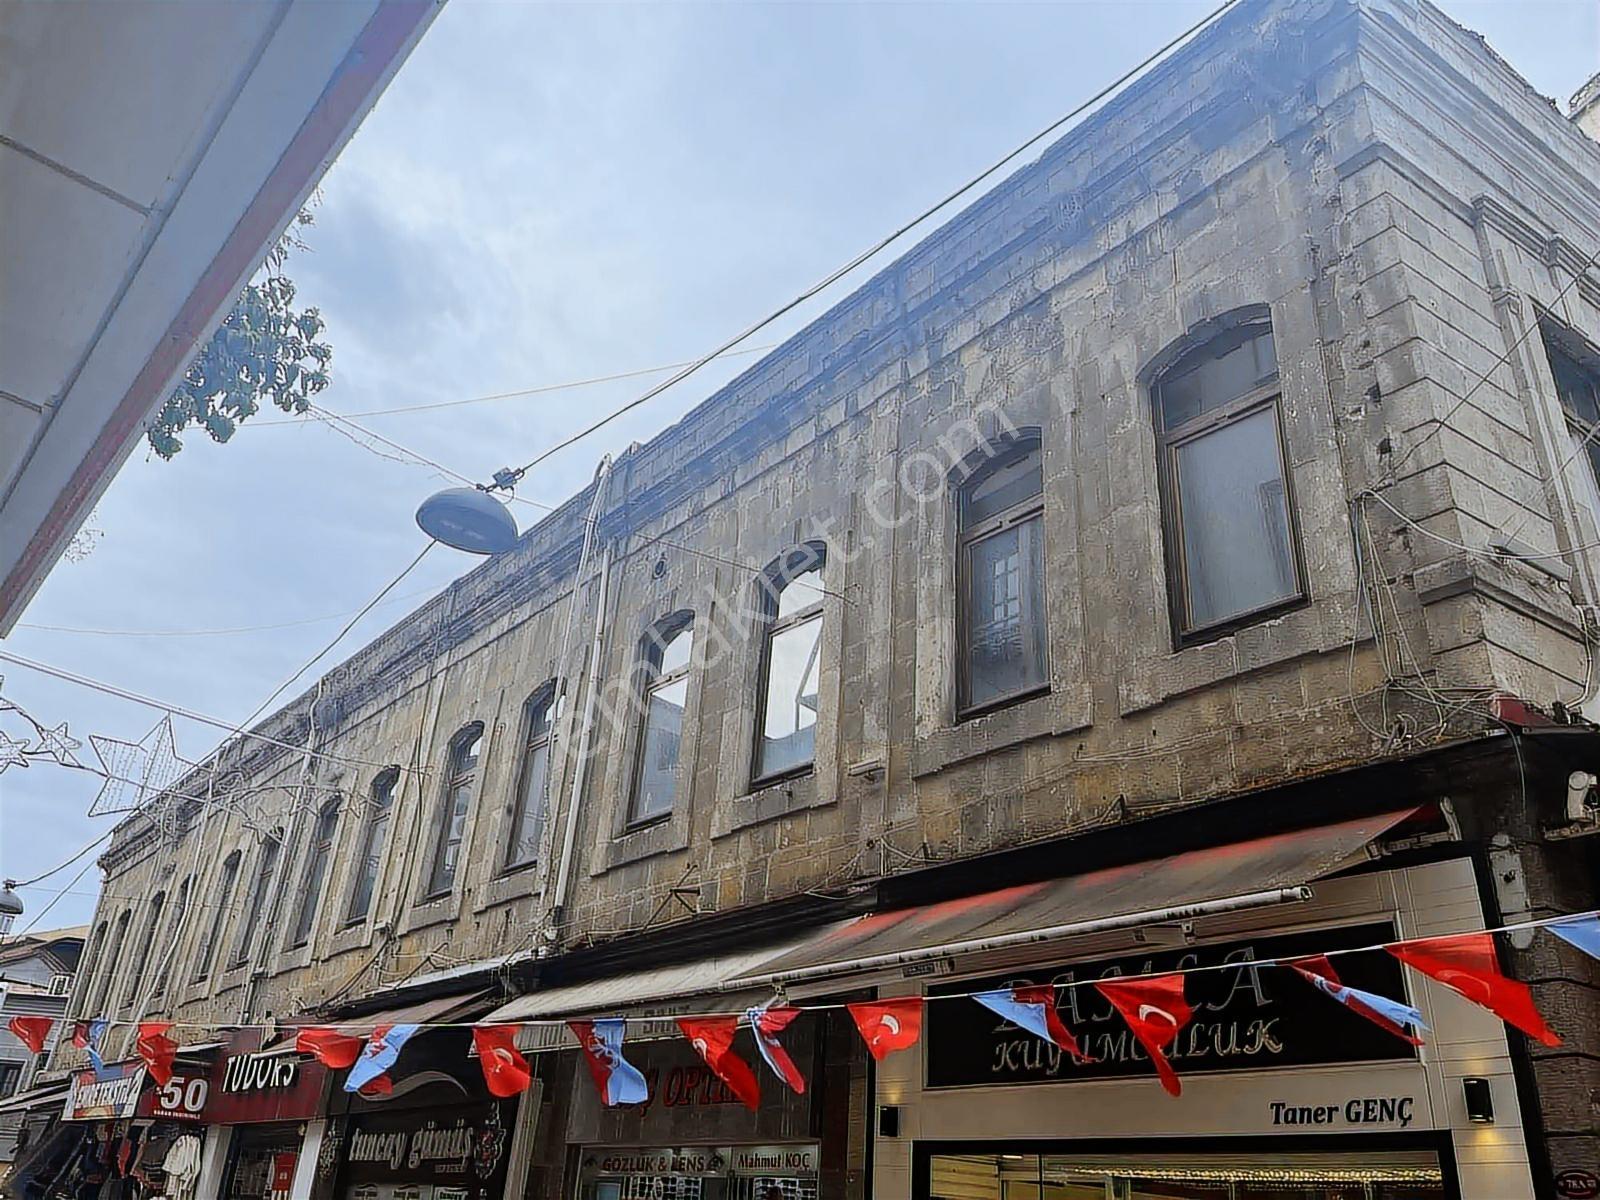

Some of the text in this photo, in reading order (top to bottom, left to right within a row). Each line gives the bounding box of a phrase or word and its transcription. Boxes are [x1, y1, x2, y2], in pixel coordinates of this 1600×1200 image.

[1269, 1097, 1414, 1128] Taner GENÇ
[348, 1118, 474, 1172] tuncay gümüş
[657, 1154, 668, 1172] &
[670, 1153, 705, 1172] LENS
[738, 1150, 811, 1171] Mahmut KOÇ
